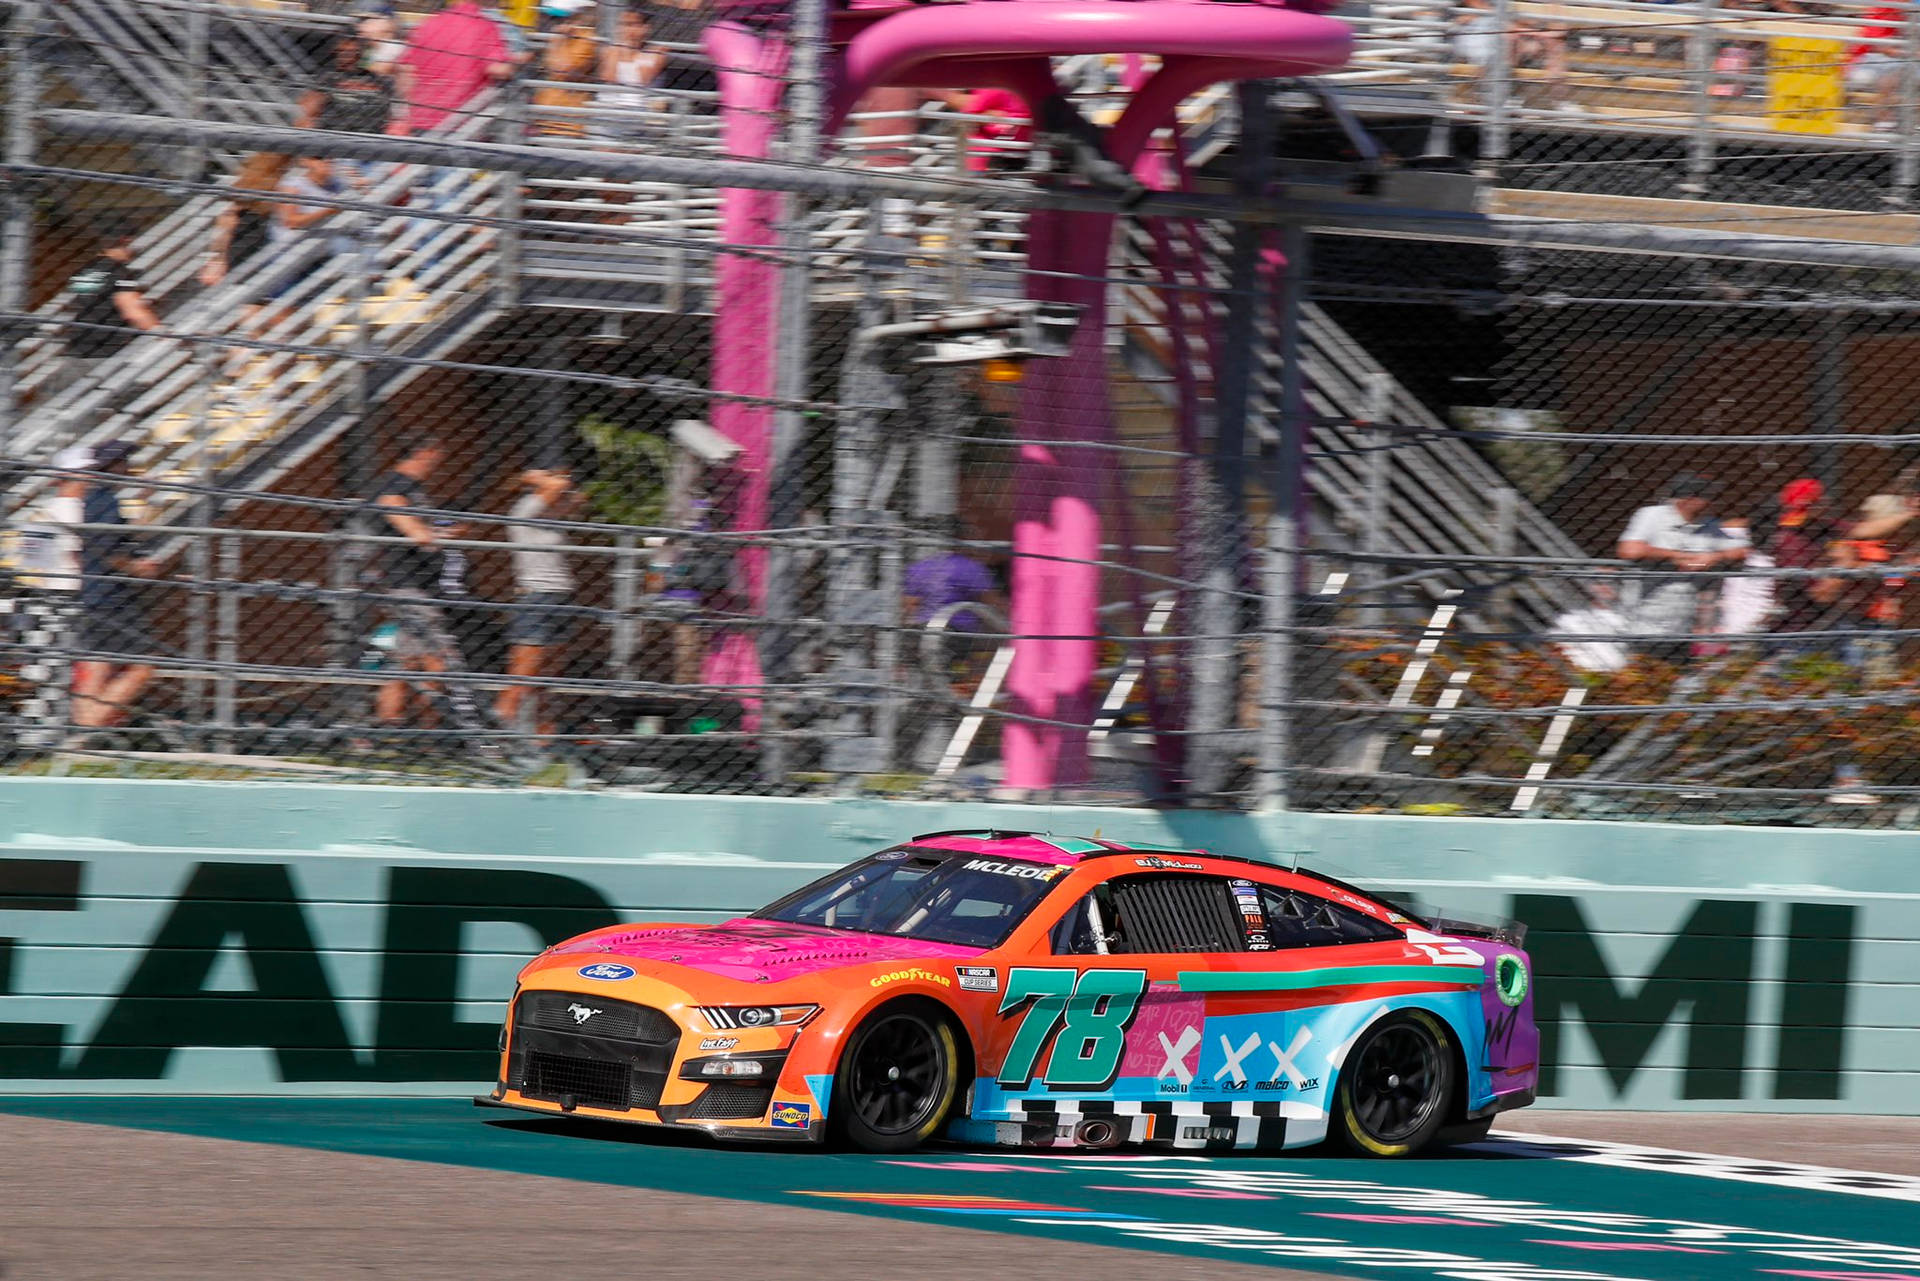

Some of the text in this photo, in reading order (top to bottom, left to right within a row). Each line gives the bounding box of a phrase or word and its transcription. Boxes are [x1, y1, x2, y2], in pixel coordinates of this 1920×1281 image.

[584, 963, 630, 979] Ford
[870, 967, 951, 988] GOODYEAR
[1365, 890, 1863, 1101] MI
[995, 966, 1149, 1090] 78
[1254, 1078, 1289, 1090] malco
[774, 1111, 808, 1120] SUNOCO
